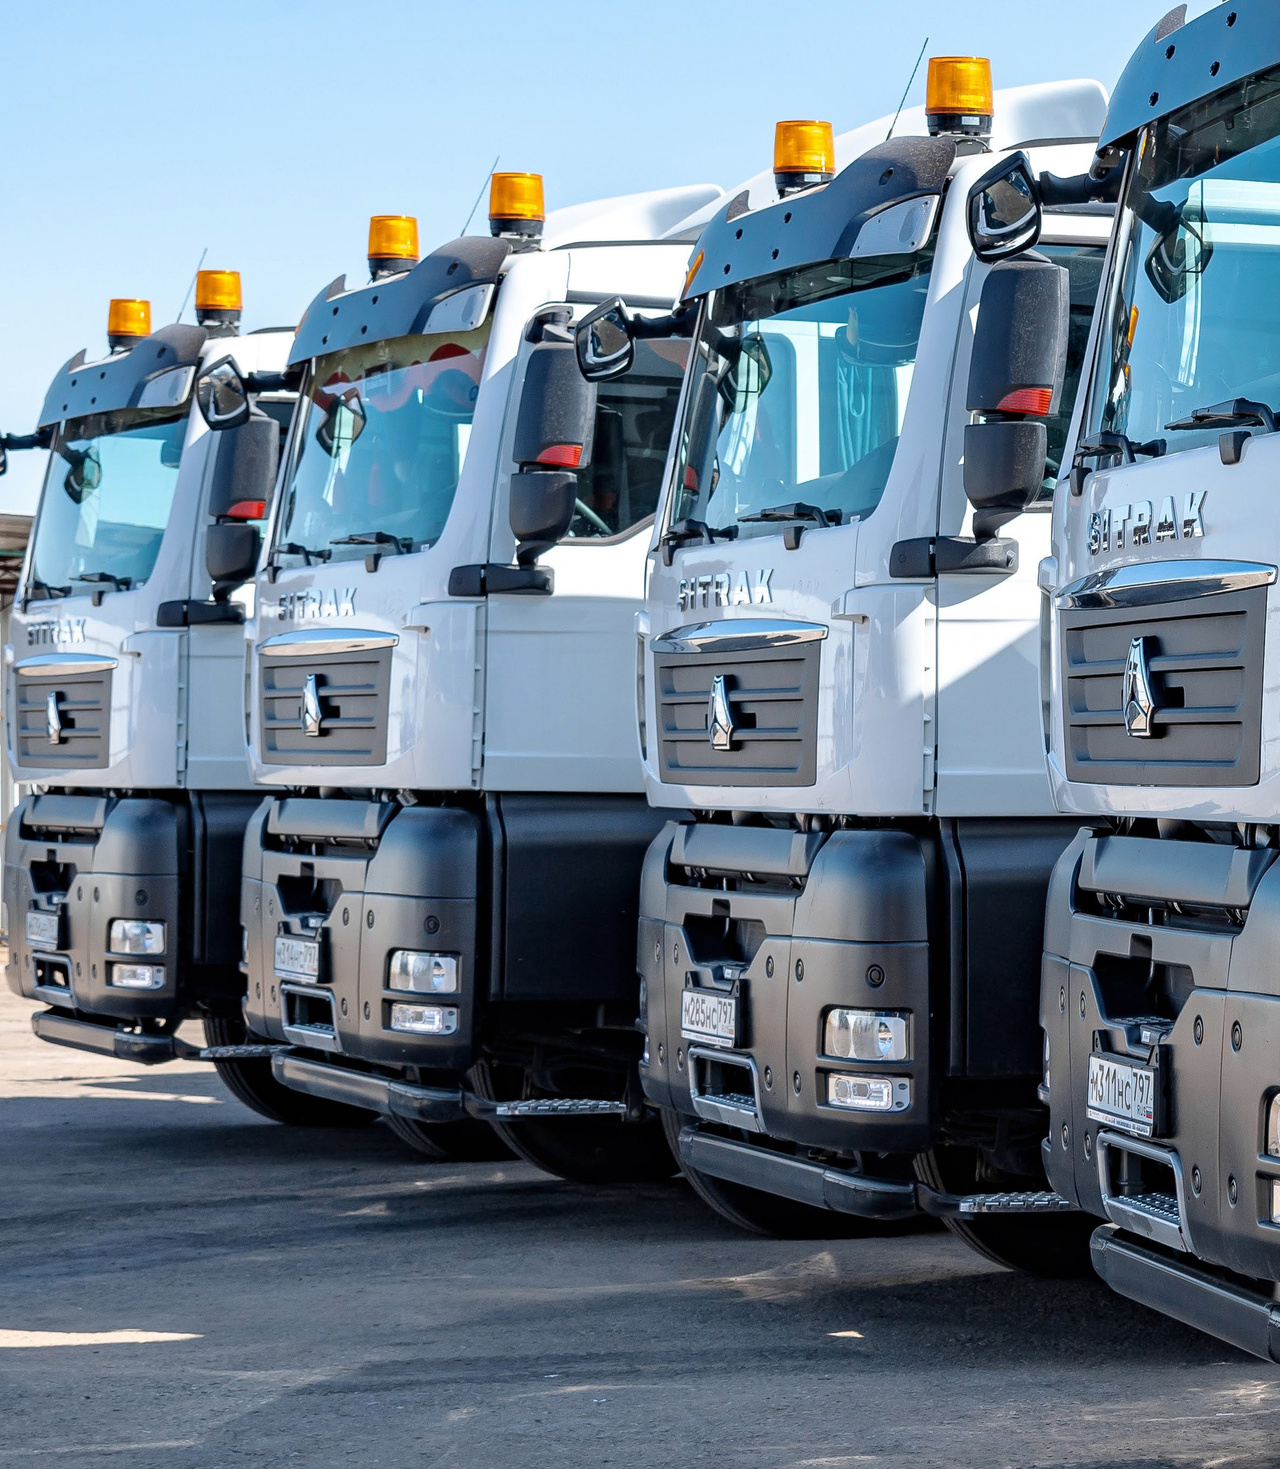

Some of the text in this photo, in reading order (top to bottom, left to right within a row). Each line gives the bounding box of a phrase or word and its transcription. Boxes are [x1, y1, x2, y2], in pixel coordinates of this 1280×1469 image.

[1087, 490, 1208, 556] SITRAK
[278, 587, 357, 620] SITRAK
[677, 568, 774, 612] SITRAK
[718, 1000, 732, 1024] 797
[1133, 1071, 1151, 1105] 797
